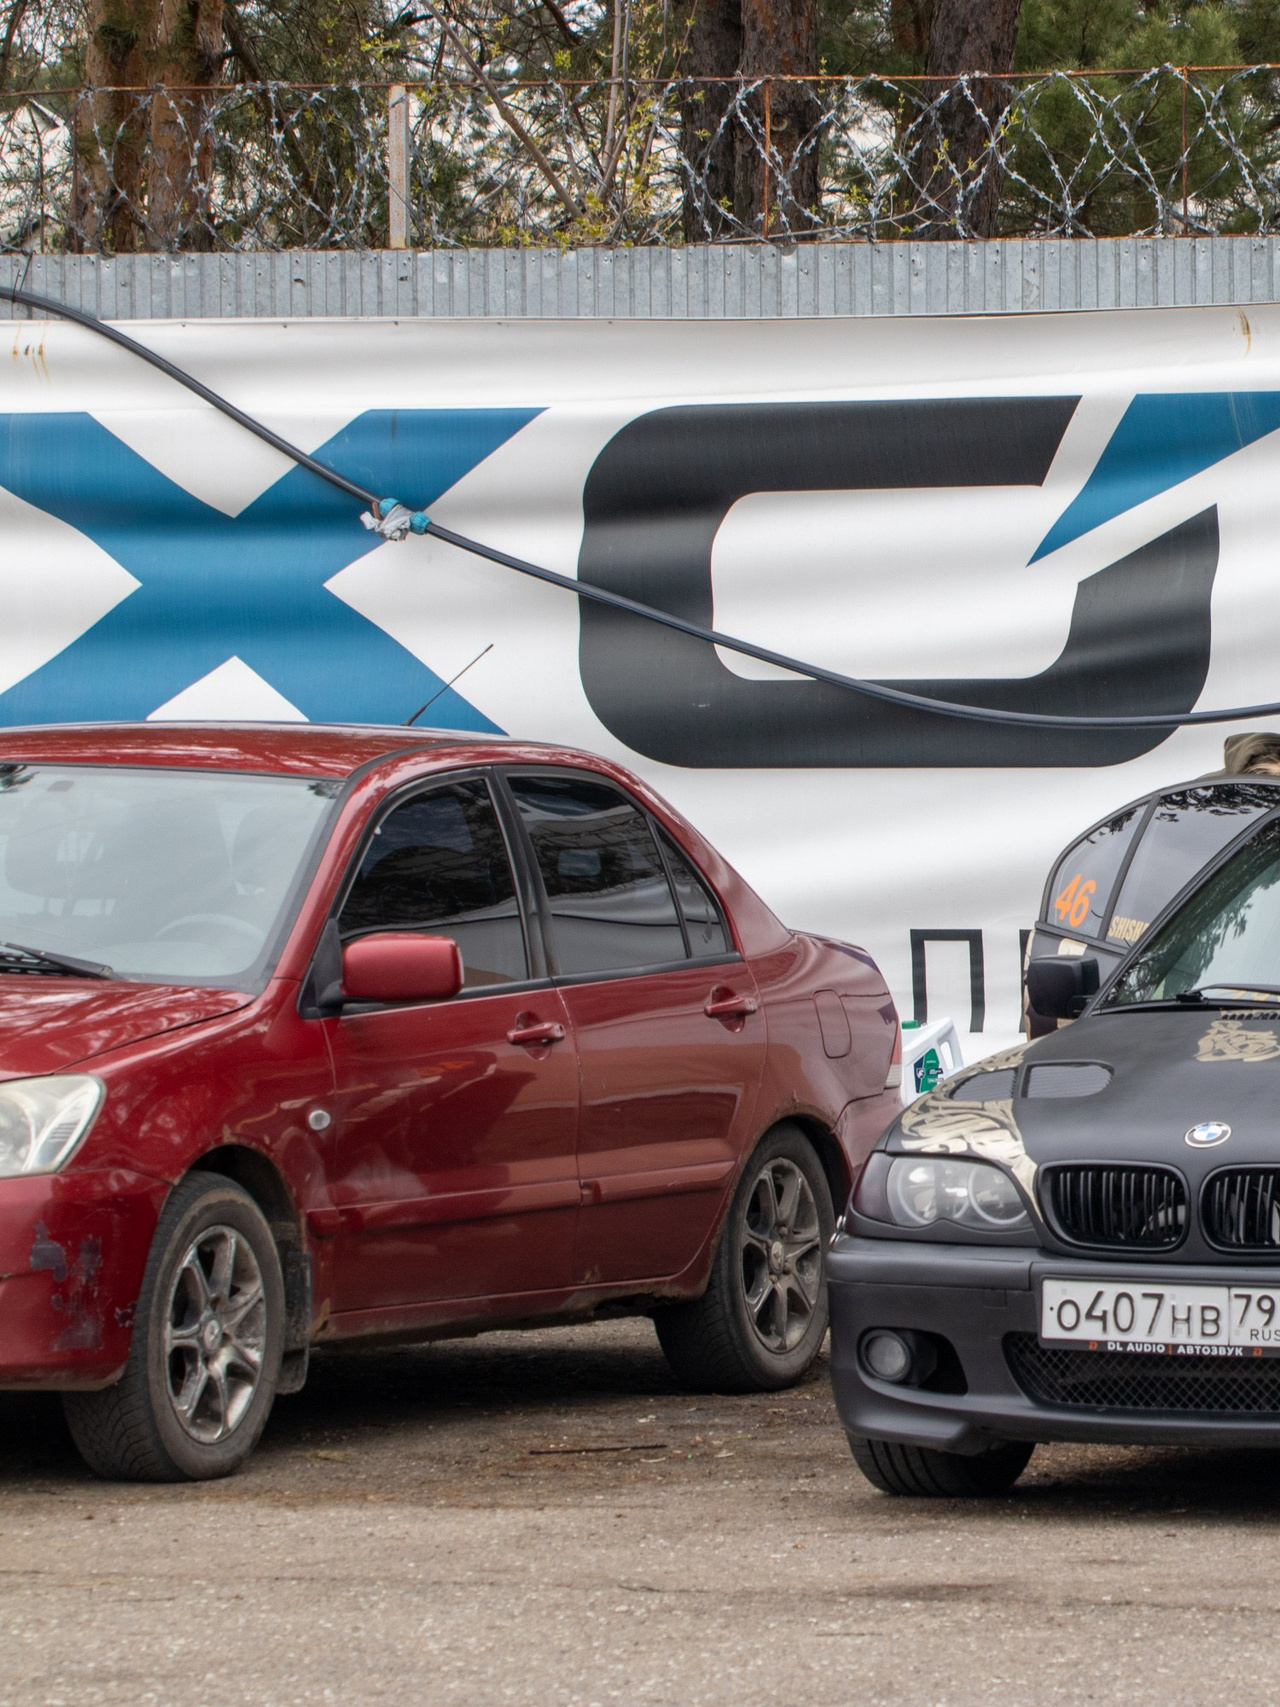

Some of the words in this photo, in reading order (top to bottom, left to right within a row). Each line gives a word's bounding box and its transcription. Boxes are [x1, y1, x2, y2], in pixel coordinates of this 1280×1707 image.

[1054, 873, 1096, 927] 46
[1106, 1341, 1124, 1351] DL
[1126, 1342, 1166, 1353] AUDIO
[1177, 1345, 1244, 1356] АВТОЗВУК
